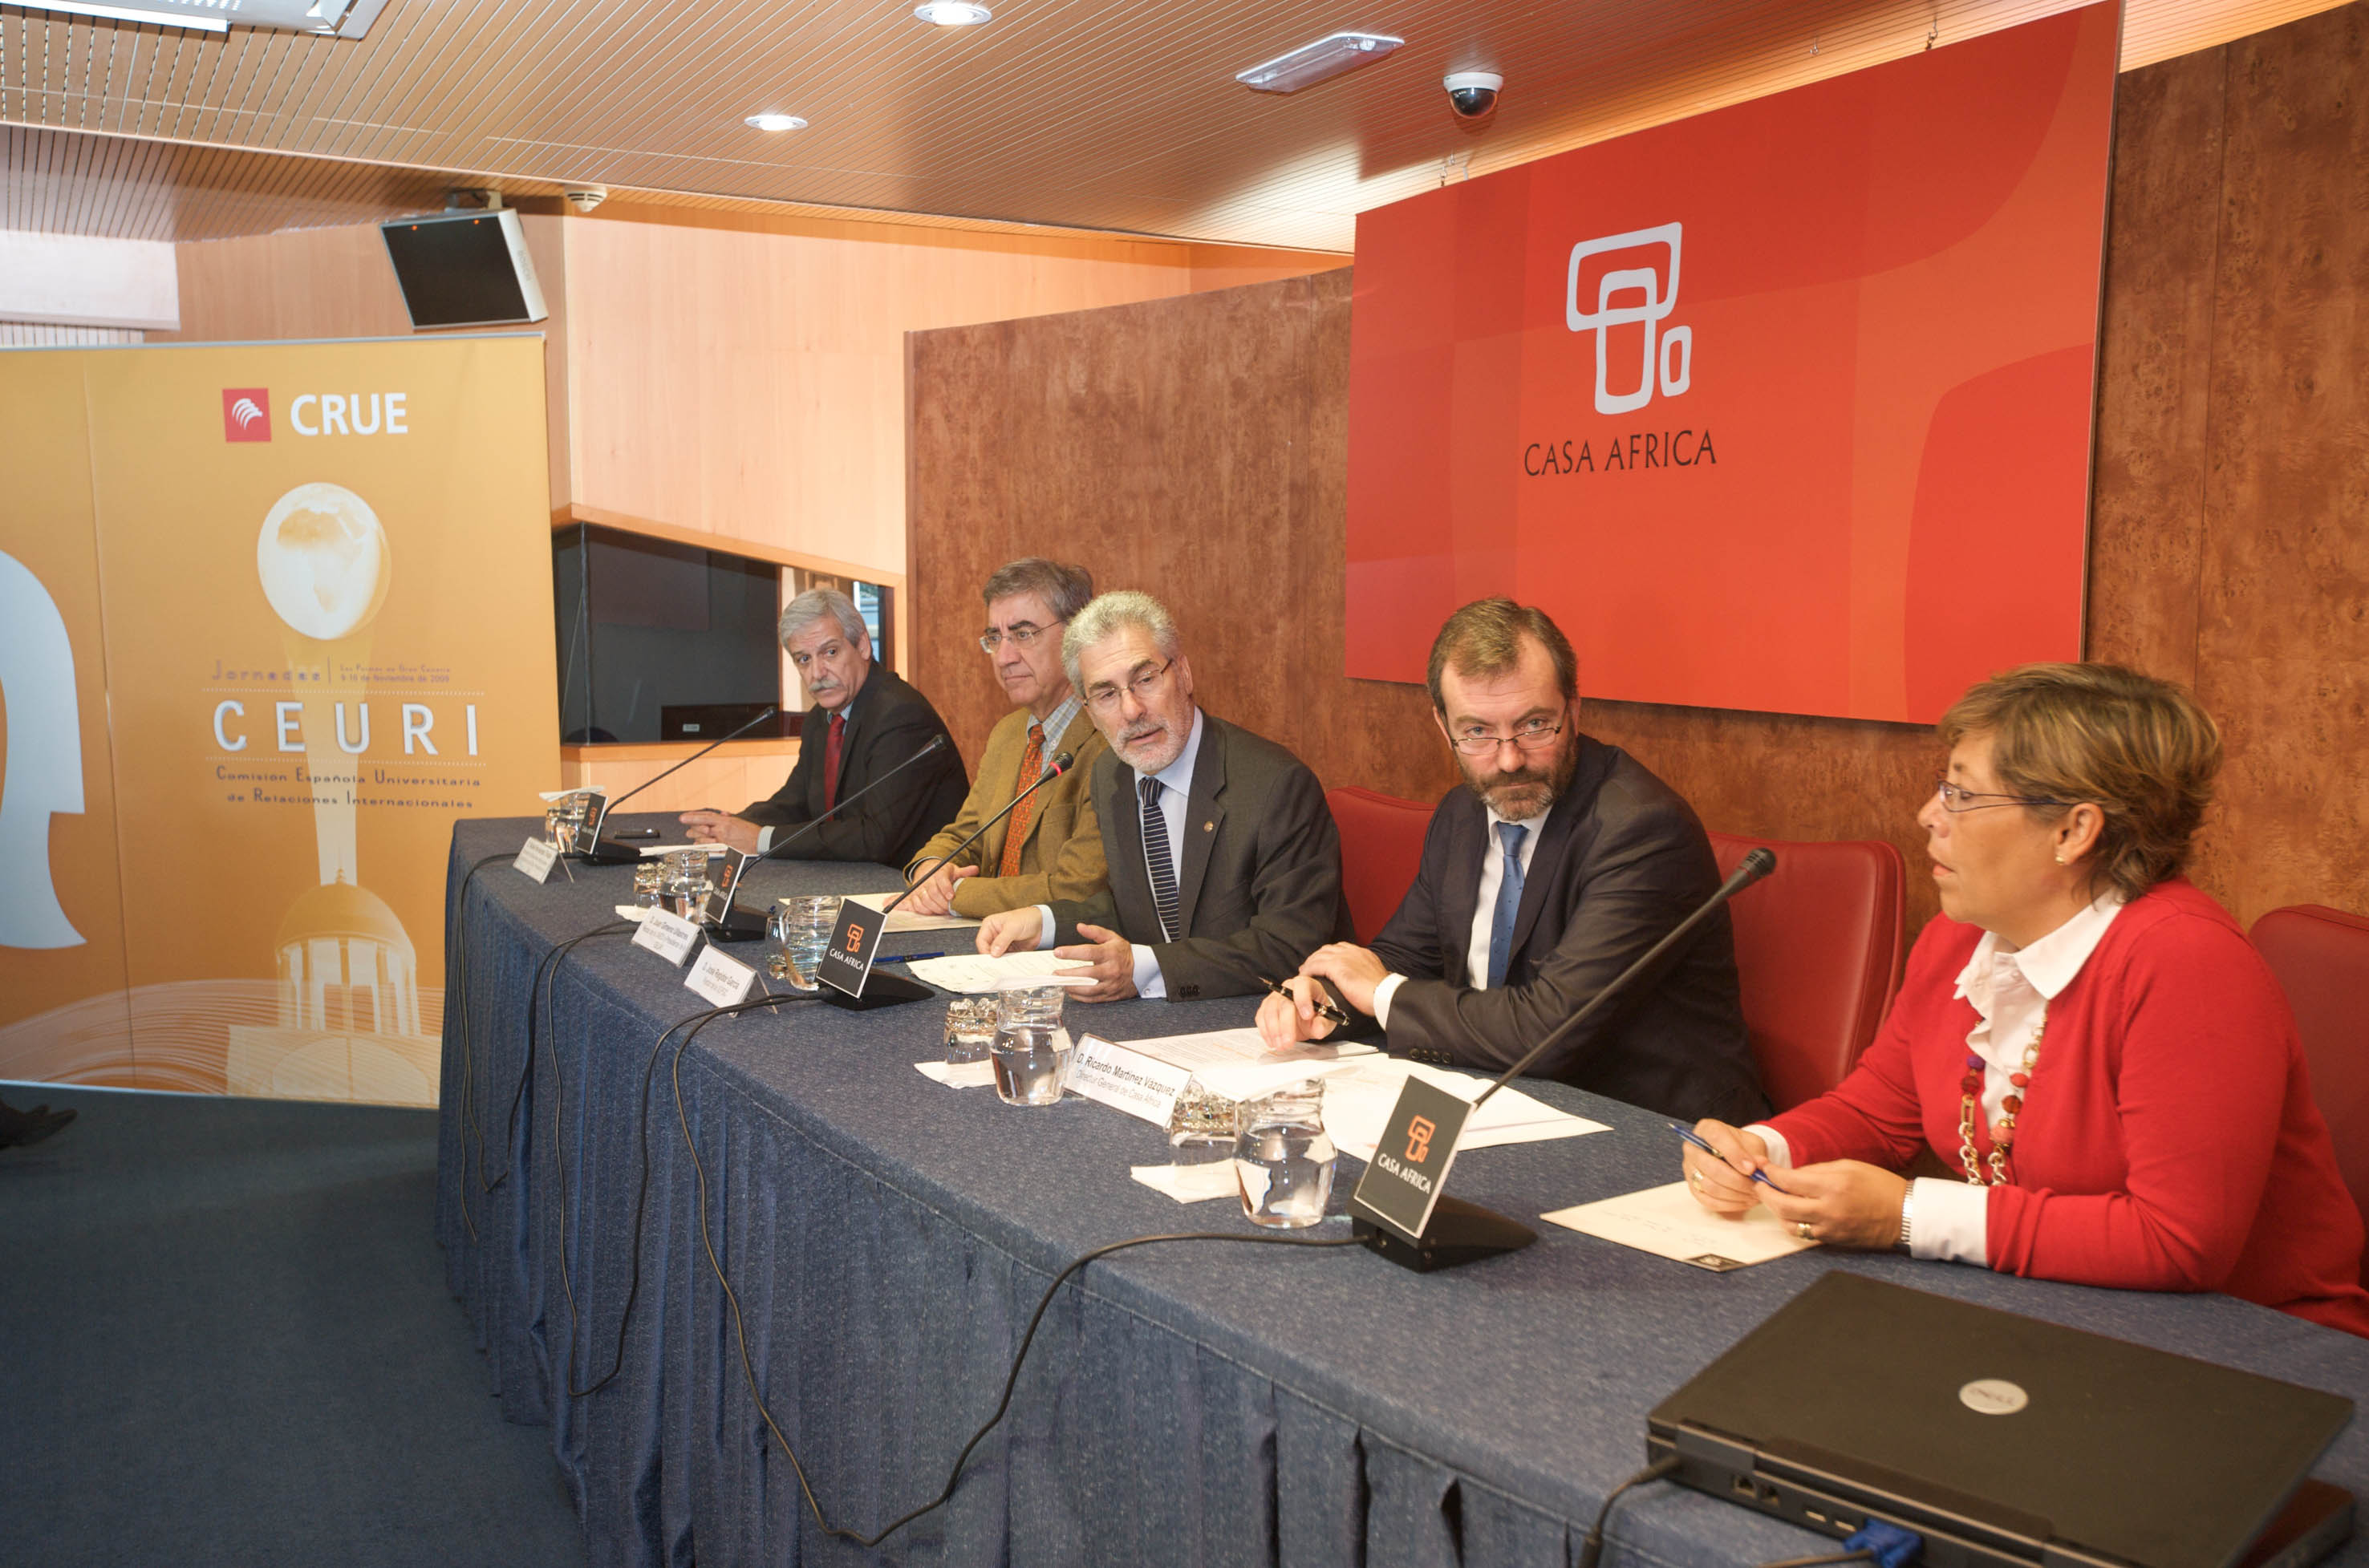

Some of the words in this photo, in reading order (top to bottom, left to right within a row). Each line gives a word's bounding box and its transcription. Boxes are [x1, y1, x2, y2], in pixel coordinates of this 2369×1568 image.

[290, 393, 408, 436] CRUE
[1524, 440, 1594, 476] CASA
[1604, 430, 1717, 471] AFRICA
[213, 700, 479, 756] CEURI
[375, 769, 480, 787] Universitaria
[227, 793, 244, 802] de
[254, 788, 338, 804] Relaciones
[347, 789, 472, 808] Internacionales
[830, 948, 843, 962] CASA
[843, 956, 864, 970] AFRICA
[1077, 1053, 1084, 1064] D.
[1085, 1056, 1112, 1074] Ricardo
[1377, 1153, 1400, 1176] CASA
[1400, 1167, 1432, 1194] AFRICA
